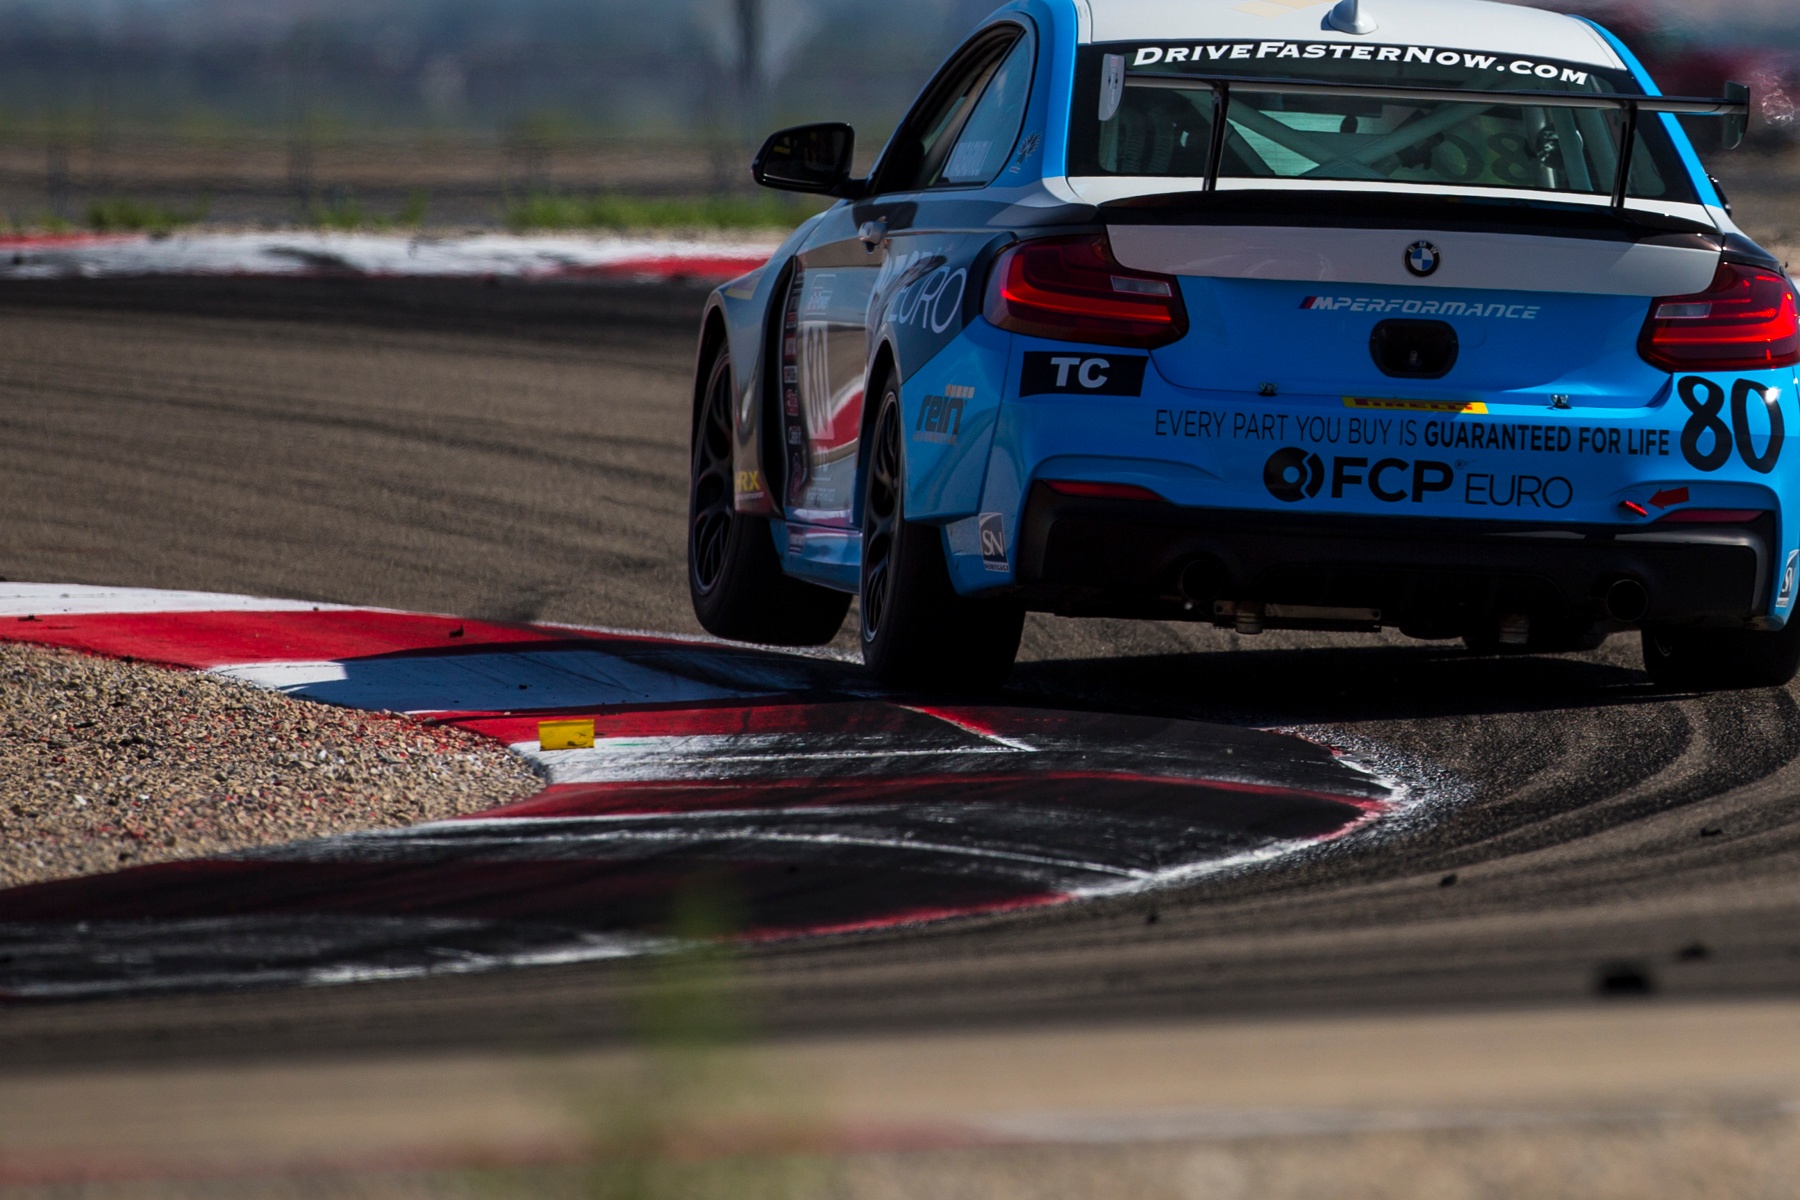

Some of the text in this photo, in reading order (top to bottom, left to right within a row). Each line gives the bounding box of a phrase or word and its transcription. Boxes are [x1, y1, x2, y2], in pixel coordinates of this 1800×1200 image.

[1050, 357, 1108, 388] TC
[915, 394, 964, 435] rein
[1155, 409, 1670, 456] EVERY PART YOU BUY IS GUARANTEED FOR LIFE
[1676, 375, 1785, 474] 80
[1331, 456, 1574, 509] FCP EURO
[982, 529, 1005, 557] SN
